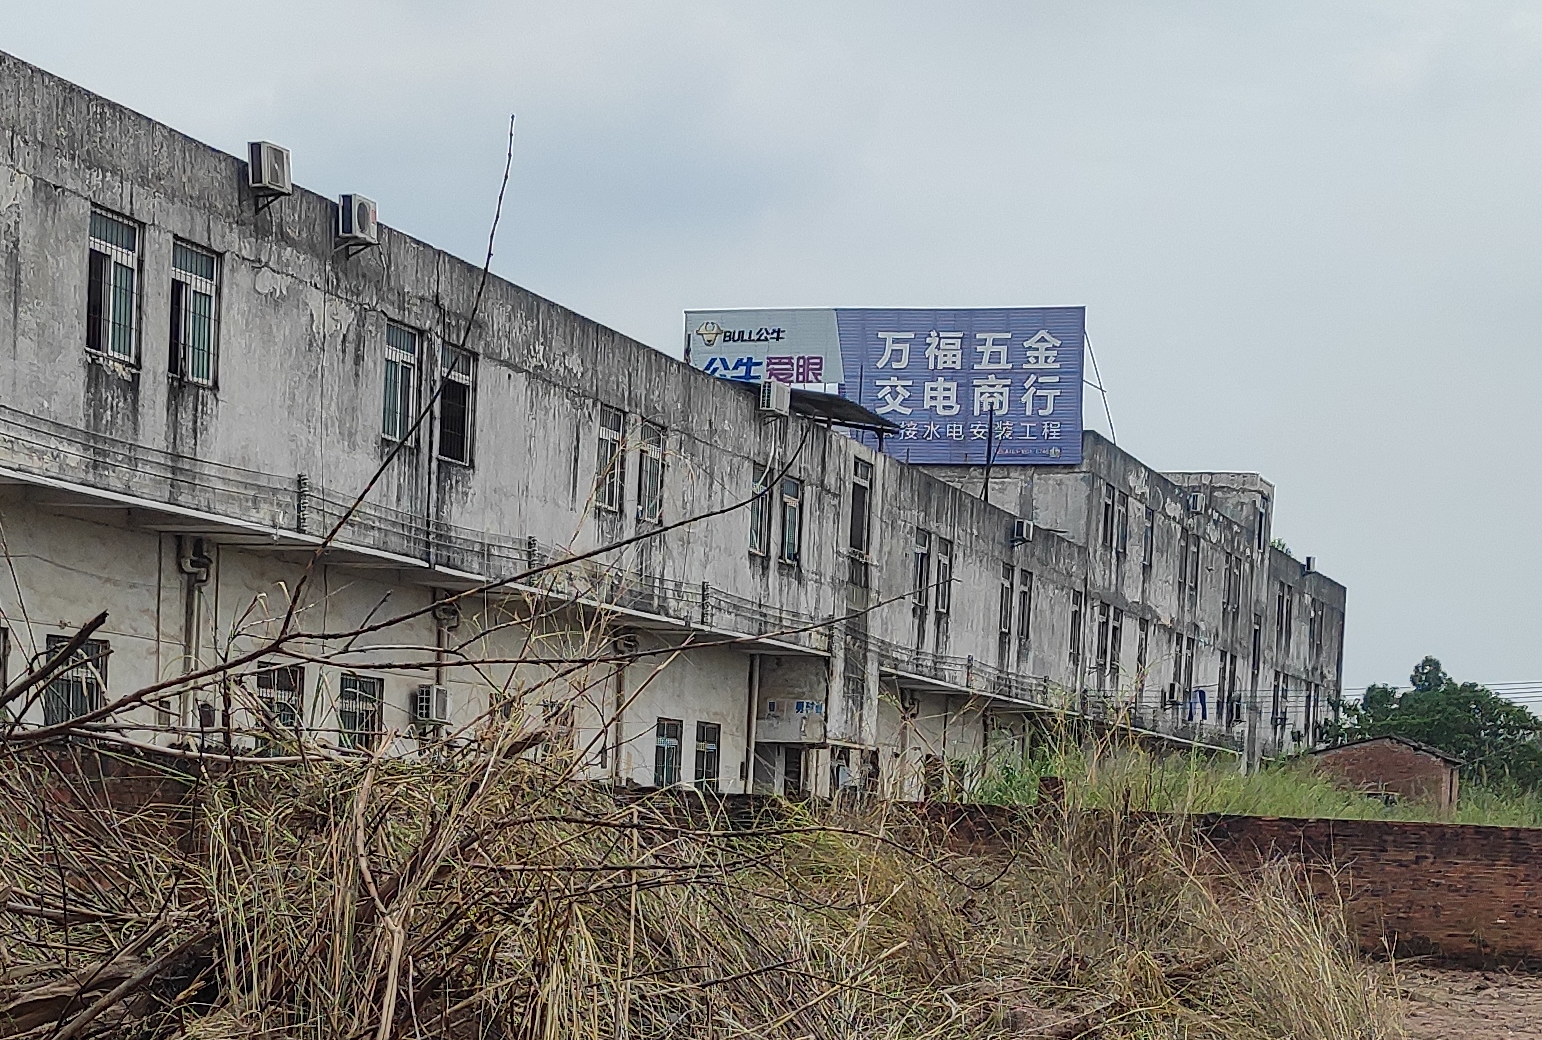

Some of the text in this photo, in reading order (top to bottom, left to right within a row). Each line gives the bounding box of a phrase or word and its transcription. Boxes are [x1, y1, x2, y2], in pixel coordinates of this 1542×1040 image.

[876, 329, 1063, 371] 万福五金
[703, 356, 824, 384] 公牛爱眼
[874, 374, 1062, 417] 交电商行
[884, 421, 1062, 441] 接水电安装工程
